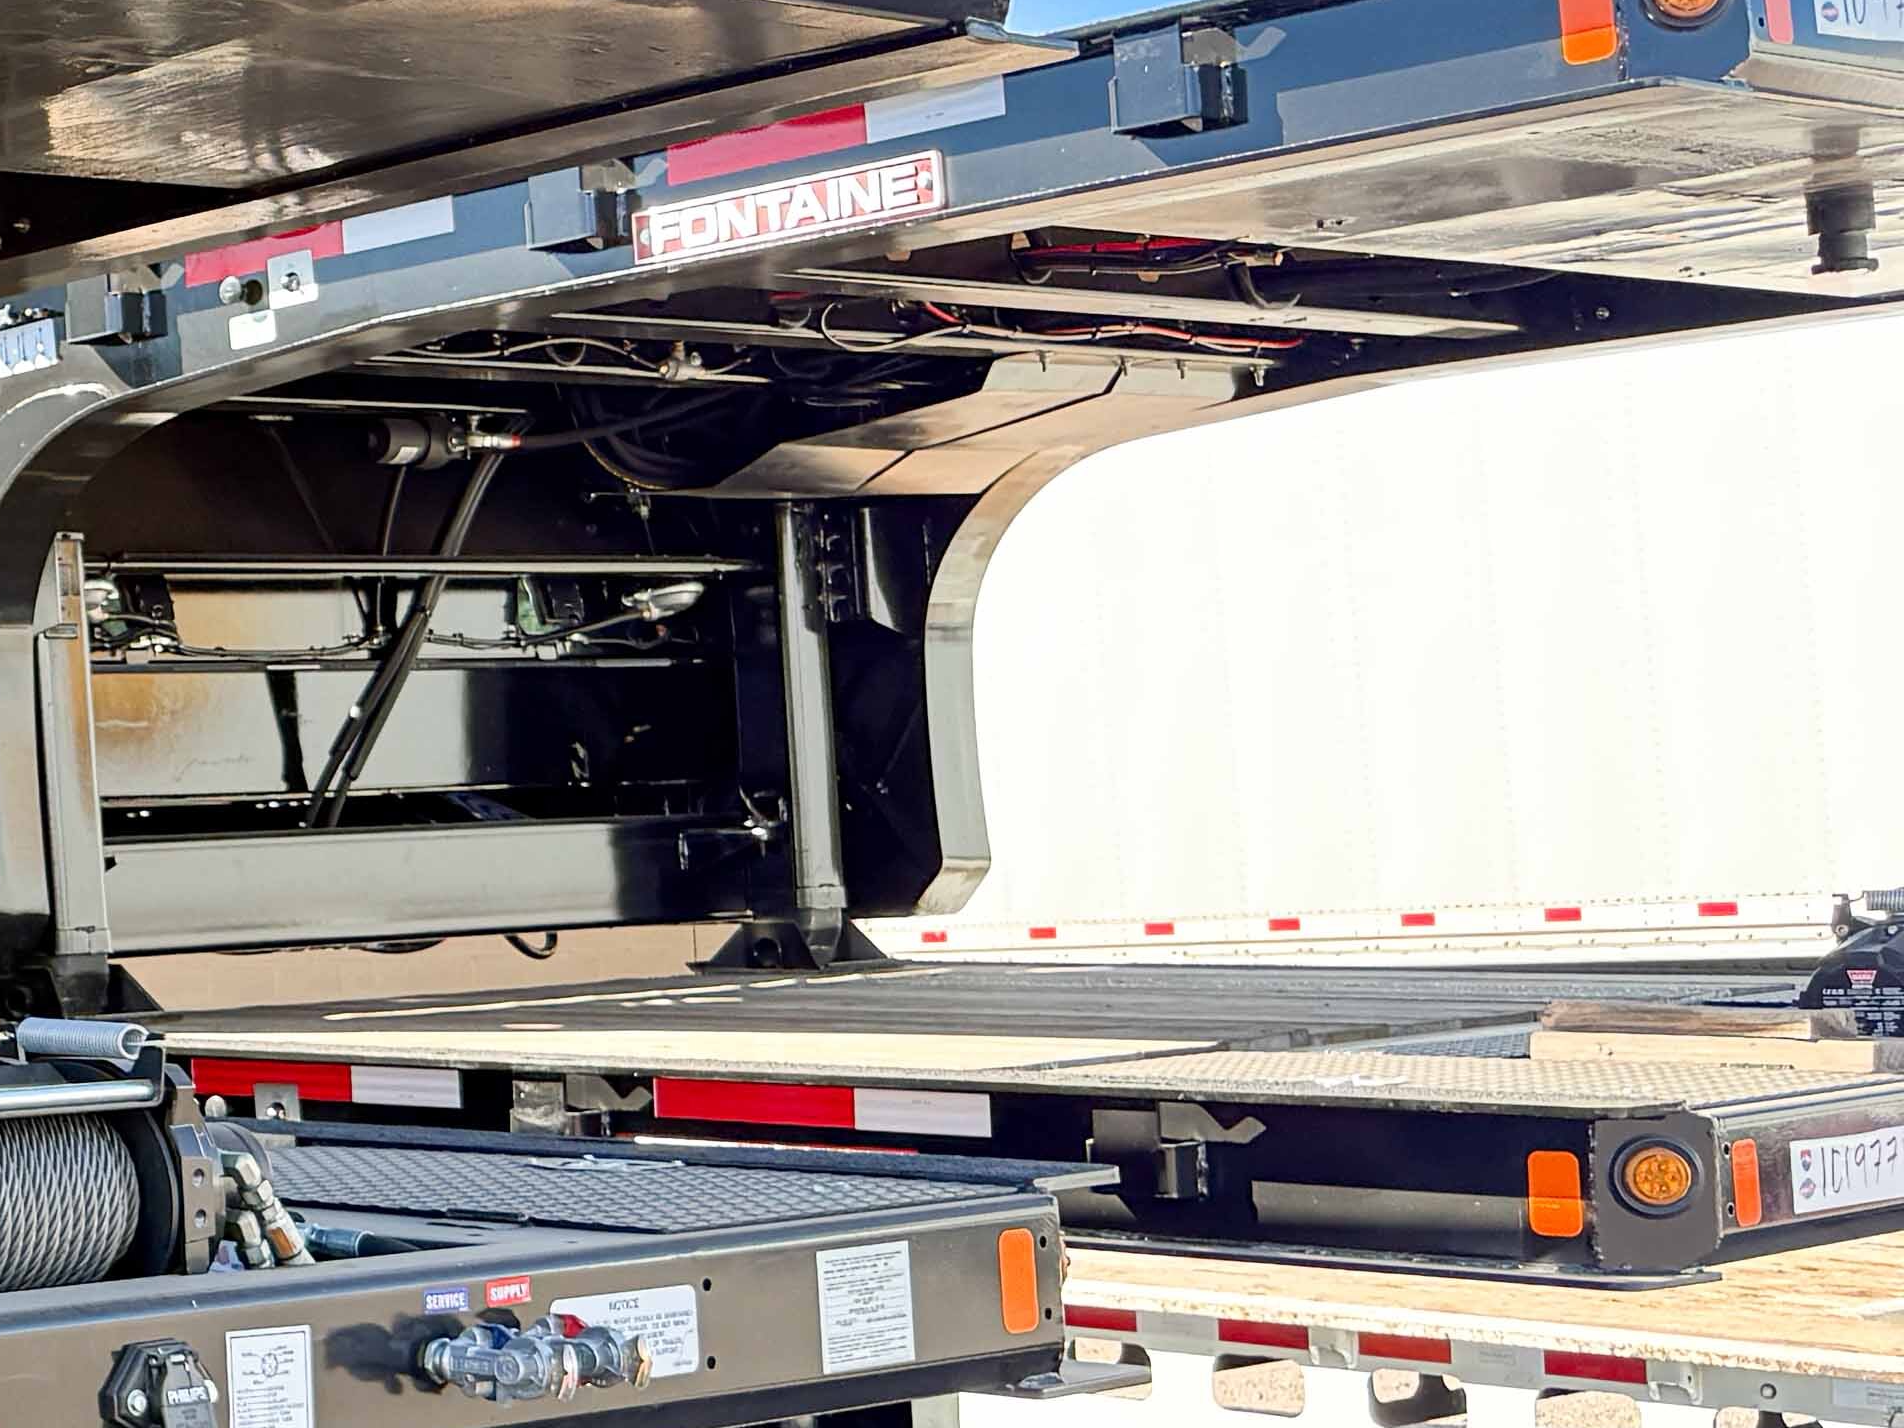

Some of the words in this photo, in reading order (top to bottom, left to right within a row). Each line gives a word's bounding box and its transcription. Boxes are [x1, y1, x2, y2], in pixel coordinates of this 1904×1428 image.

[648, 164, 919, 256] FONTAINE
[426, 1292, 465, 1310] SERVICE
[490, 1282, 528, 1302] SUPPLY
